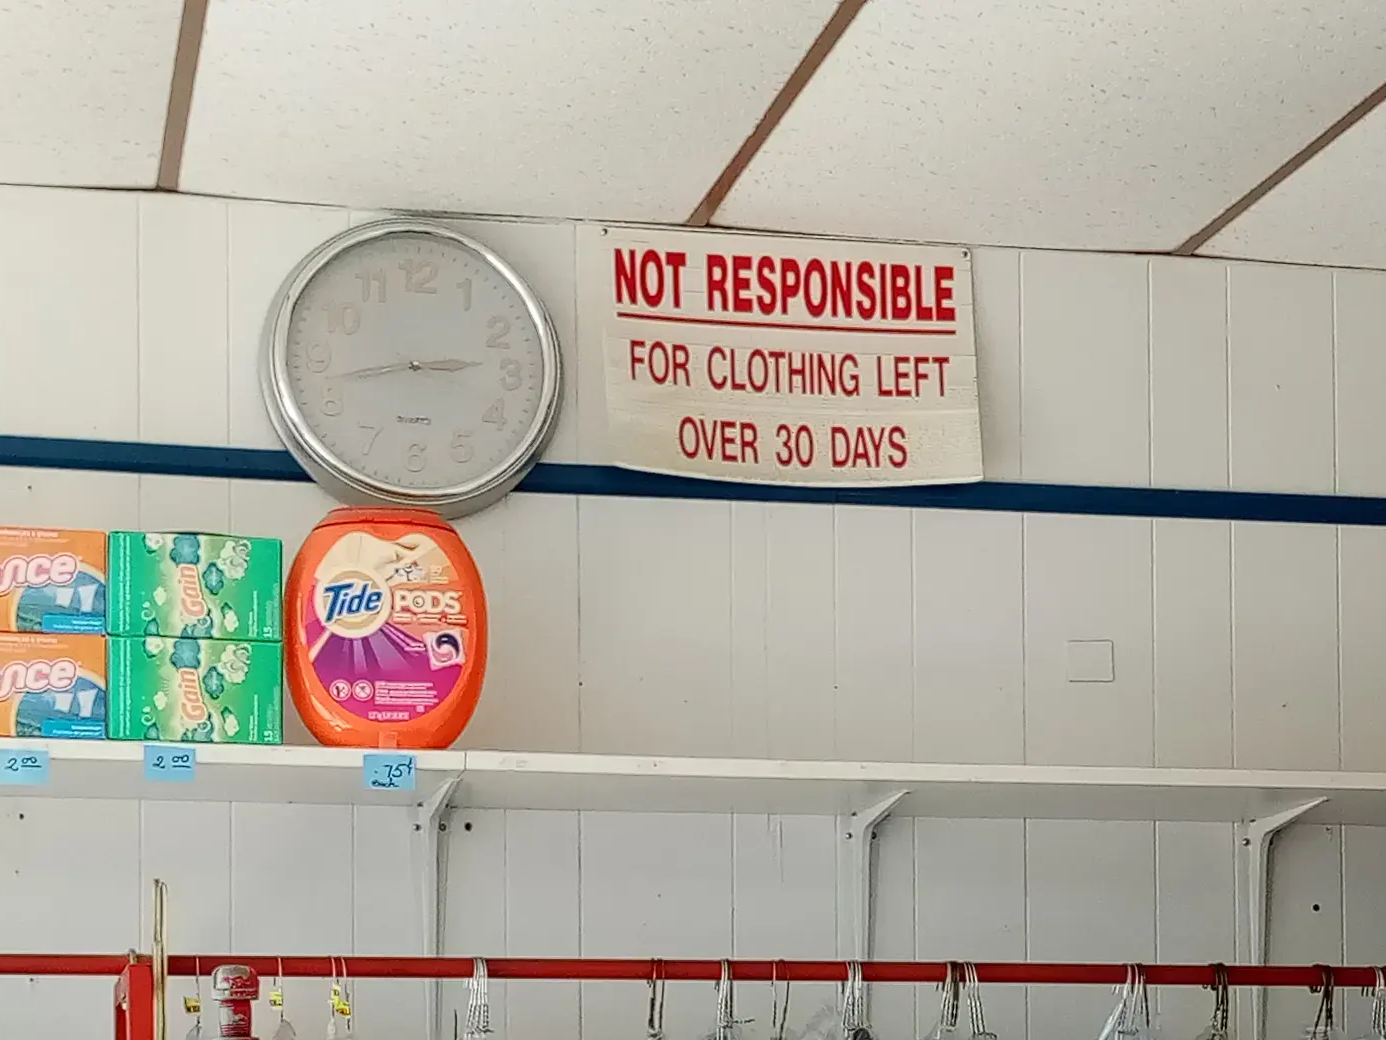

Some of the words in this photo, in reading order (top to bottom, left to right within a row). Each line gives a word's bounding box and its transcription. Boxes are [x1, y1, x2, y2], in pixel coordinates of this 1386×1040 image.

[355, 269, 386, 303] 11
[398, 259, 438, 294] 12
[614, 248, 686, 309] NOT
[707, 254, 956, 322] RESPONSIBLE
[456, 278, 472, 311] 1
[321, 301, 360, 335] 10
[485, 315, 511, 349] 2
[306, 343, 331, 373] 9
[499, 358, 522, 391] 3
[630, 339, 691, 386] FOR
[707, 345, 860, 398] CLOTHING
[877, 356, 950, 397] LEFT
[320, 385, 343, 417] 8
[482, 398, 507, 431] 4
[358, 423, 384, 456] 7
[450, 430, 473, 464] 5
[679, 416, 759, 464] OVER
[776, 424, 814, 467] 30
[831, 425, 908, 468] DAYS
[404, 443, 427, 472] 6
[178, 564, 207, 618] Gain
[323, 582, 383, 624] Tide
[394, 590, 462, 614] PODS
[179, 667, 207, 722] Gain
